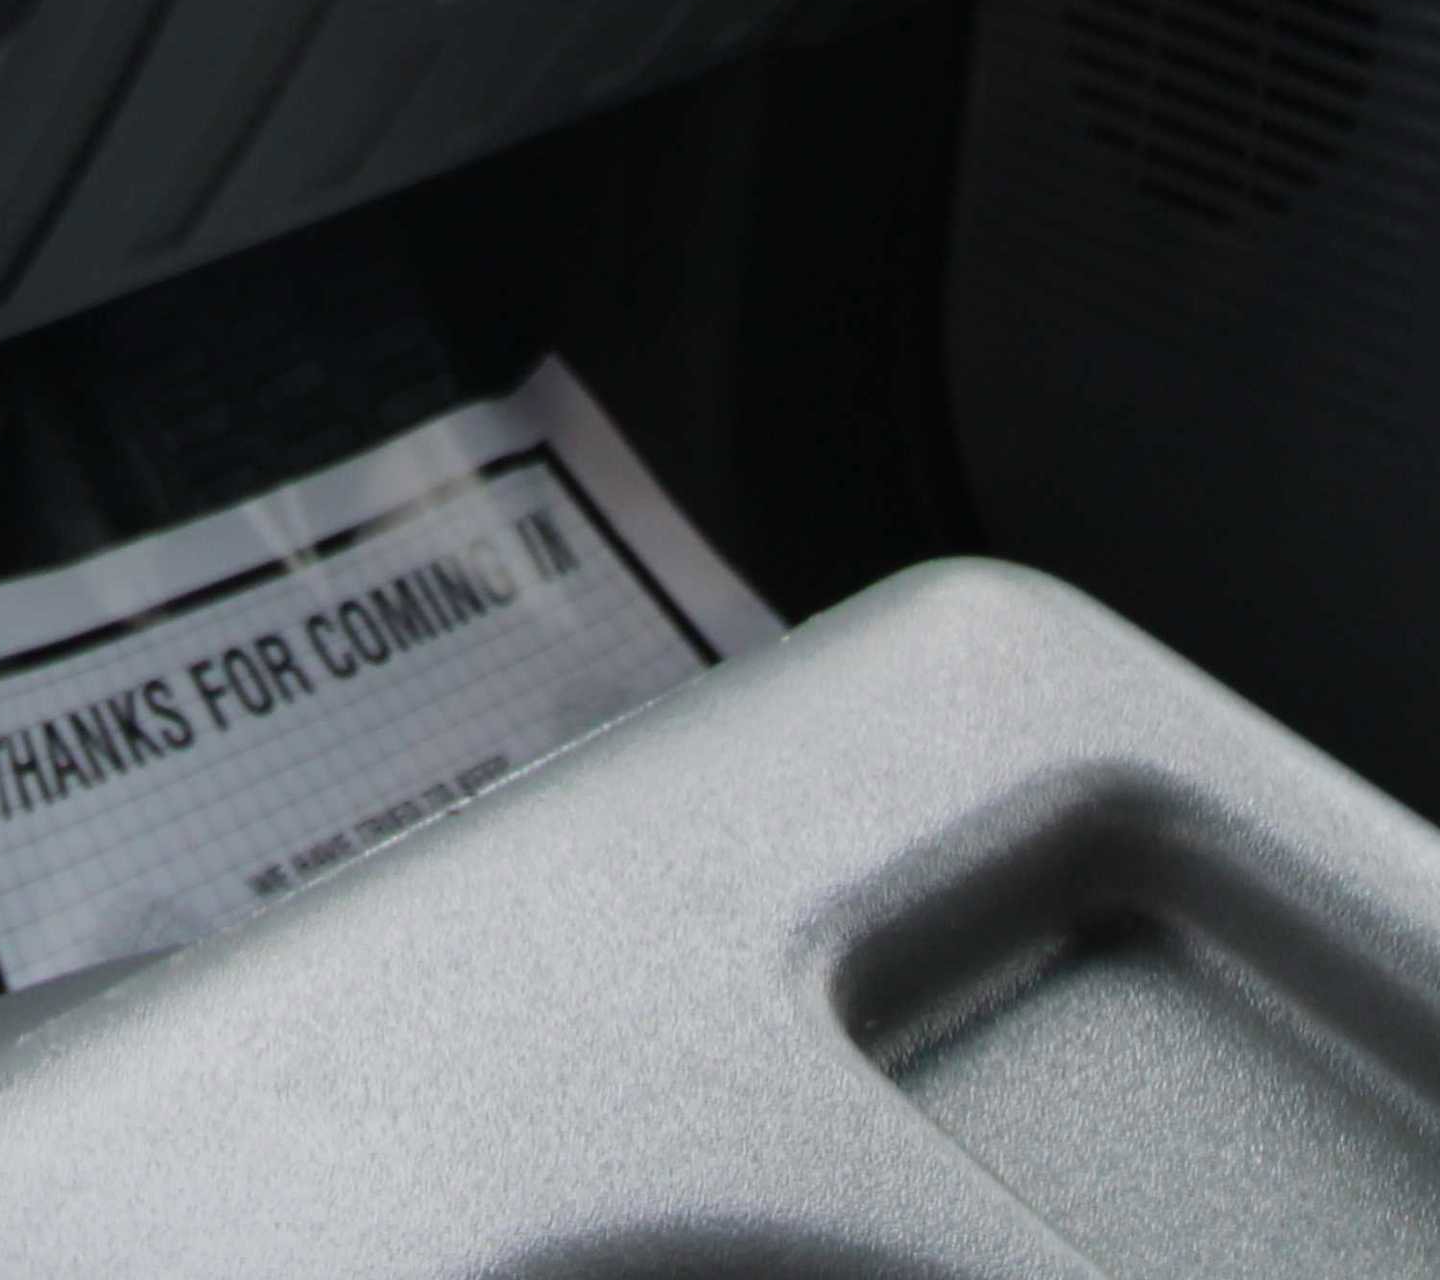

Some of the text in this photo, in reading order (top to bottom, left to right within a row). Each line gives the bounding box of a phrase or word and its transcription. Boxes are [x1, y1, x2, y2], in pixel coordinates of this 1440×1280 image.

[189, 641, 312, 733] FOR
[308, 536, 517, 681] COMING
[514, 508, 580, 582] IN
